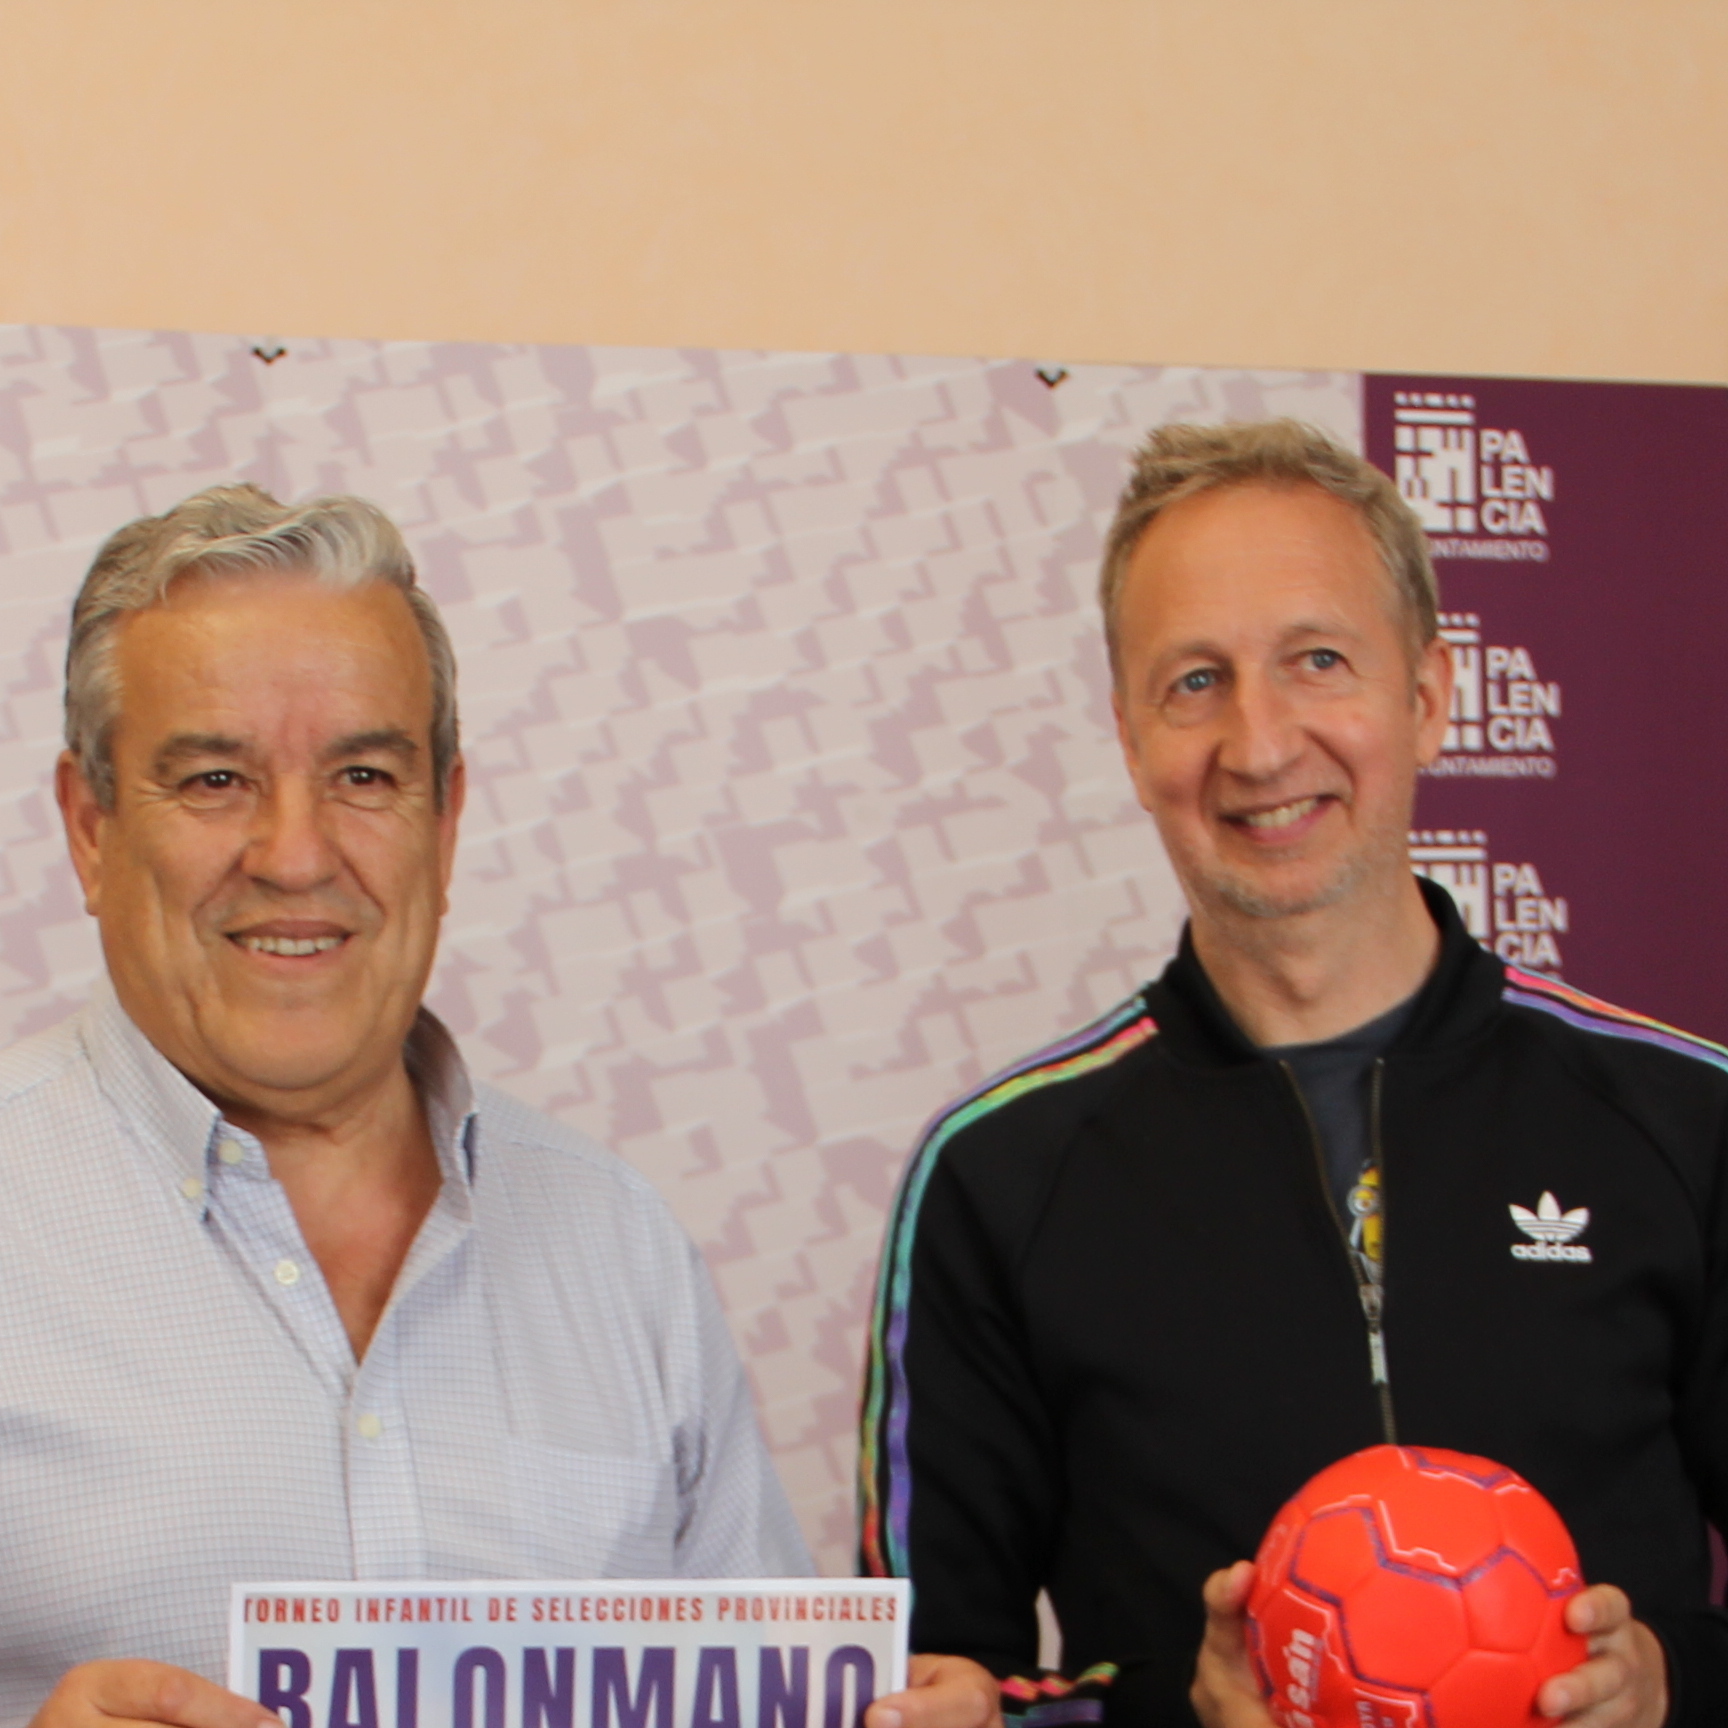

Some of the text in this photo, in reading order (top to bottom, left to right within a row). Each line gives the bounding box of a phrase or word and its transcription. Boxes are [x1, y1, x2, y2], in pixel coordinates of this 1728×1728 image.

[1480, 429, 1530, 464] PA
[1480, 465, 1554, 501] LEN
[1480, 502, 1548, 536] CIA
[1487, 646, 1537, 680] PA
[1488, 682, 1561, 717] LEN
[1488, 719, 1554, 752] CIA
[1494, 864, 1542, 897] PA
[1494, 898, 1568, 932] LEN
[1494, 933, 1561, 967] CIA
[1511, 1241, 1592, 1263] adidas
[355, 1597, 474, 1622] INFANTIL
[488, 1597, 518, 1622] DE
[532, 1597, 704, 1622] SELECCIONES
[718, 1596, 897, 1622] PROVINCIALES
